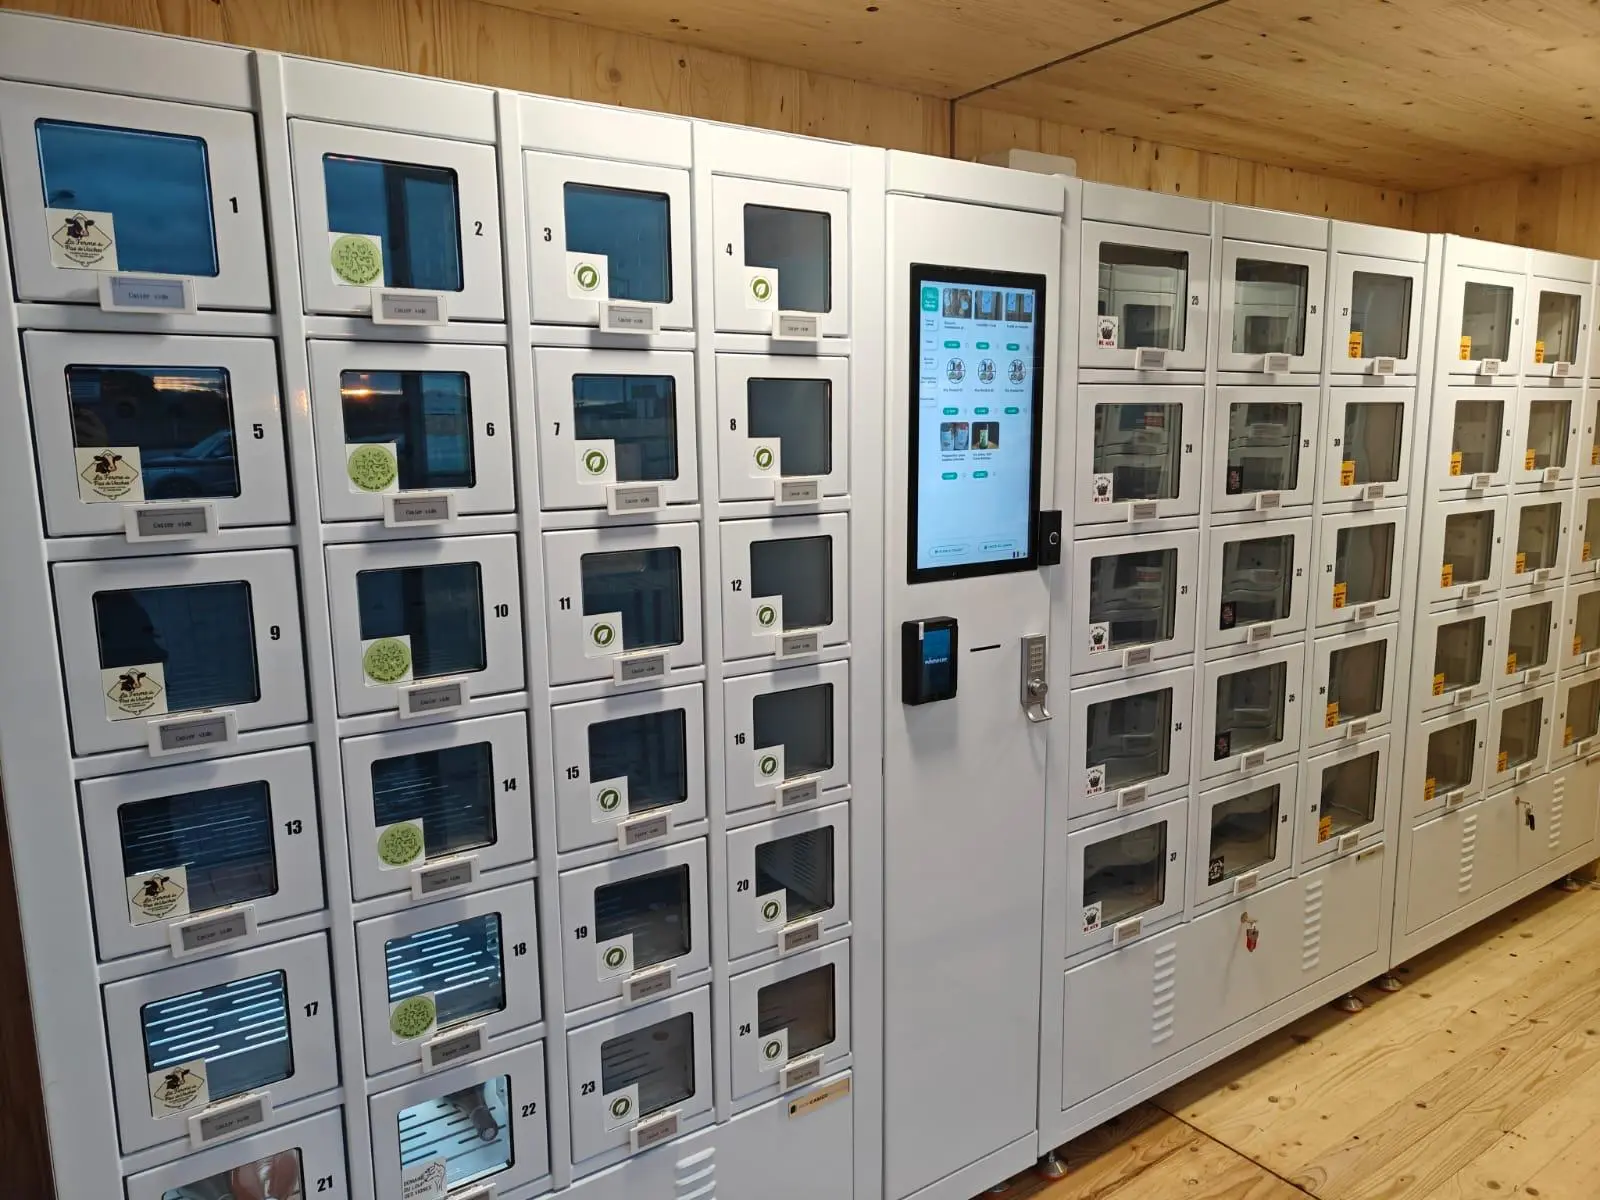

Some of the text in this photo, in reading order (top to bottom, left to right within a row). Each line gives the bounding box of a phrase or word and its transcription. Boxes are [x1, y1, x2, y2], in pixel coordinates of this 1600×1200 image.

[229, 196, 239, 213] 1
[475, 221, 484, 236] 2
[544, 228, 552, 242] 3
[726, 243, 733, 256] 4
[253, 424, 264, 439] 5
[487, 422, 495, 436] 6
[554, 422, 560, 436] 7
[730, 419, 736, 431] 8
[731, 580, 741, 592] 12
[559, 597, 570, 610] 11
[494, 604, 508, 618] 10
[270, 625, 280, 640] 9
[734, 733, 745, 745] 16
[566, 766, 579, 779] 15
[503, 777, 517, 792] 14
[285, 819, 302, 836] 13
[737, 879, 749, 892] 20
[574, 926, 587, 939] 19
[513, 942, 526, 957] 18
[304, 1001, 319, 1018] 17
[740, 1023, 751, 1036] 24
[581, 1081, 595, 1096] 23
[522, 1102, 536, 1117] 22
[317, 1175, 333, 1193] 21
